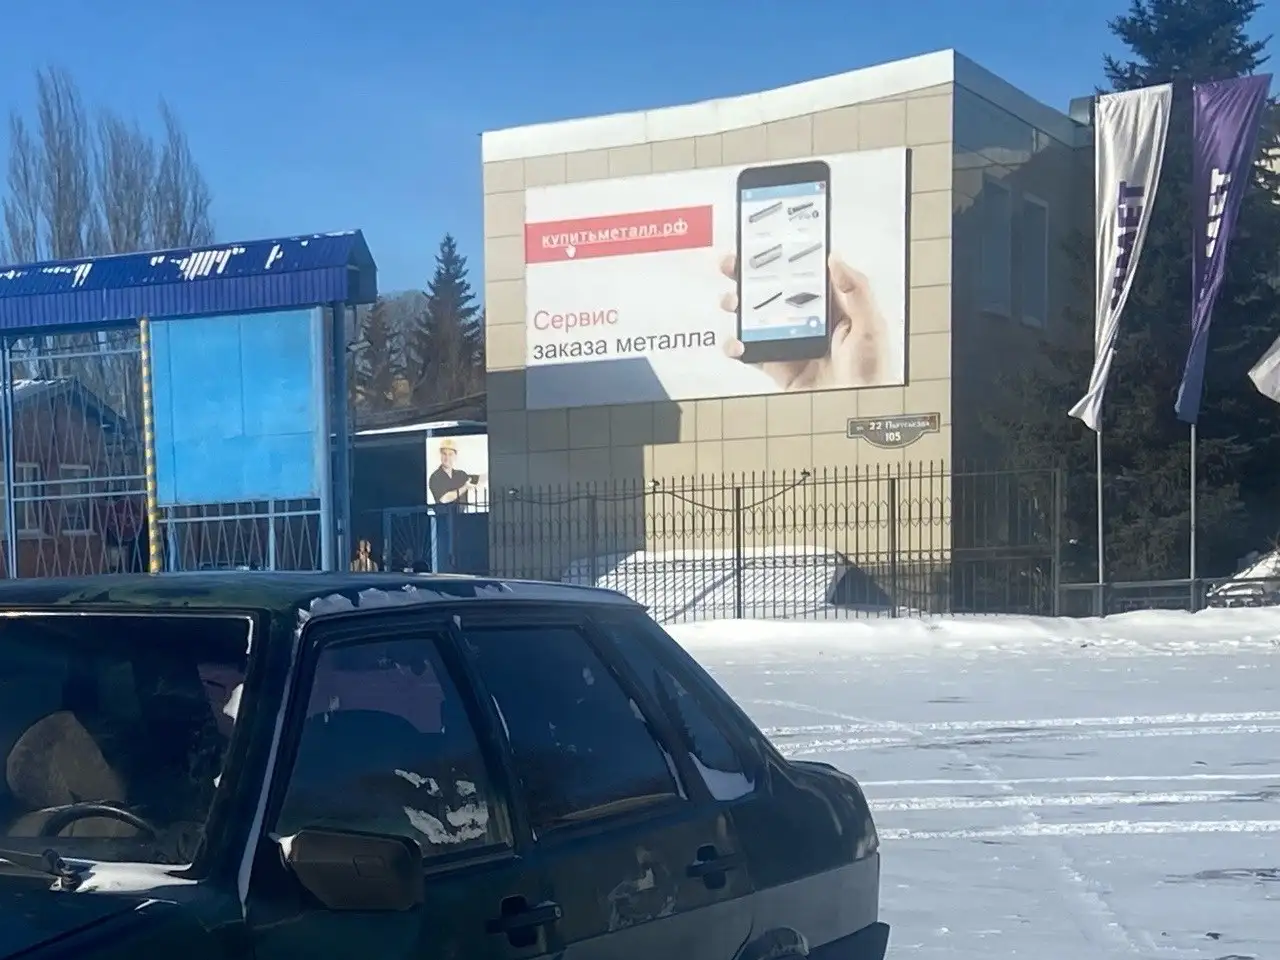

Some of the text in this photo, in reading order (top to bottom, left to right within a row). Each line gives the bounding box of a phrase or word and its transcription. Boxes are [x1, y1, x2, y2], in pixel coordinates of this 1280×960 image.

[541, 217, 689, 248] купитьметалл.рф
[533, 308, 619, 333] Сервис
[533, 330, 716, 360] заказа металла
[869, 421, 882, 431] 22
[885, 432, 901, 442] 105
